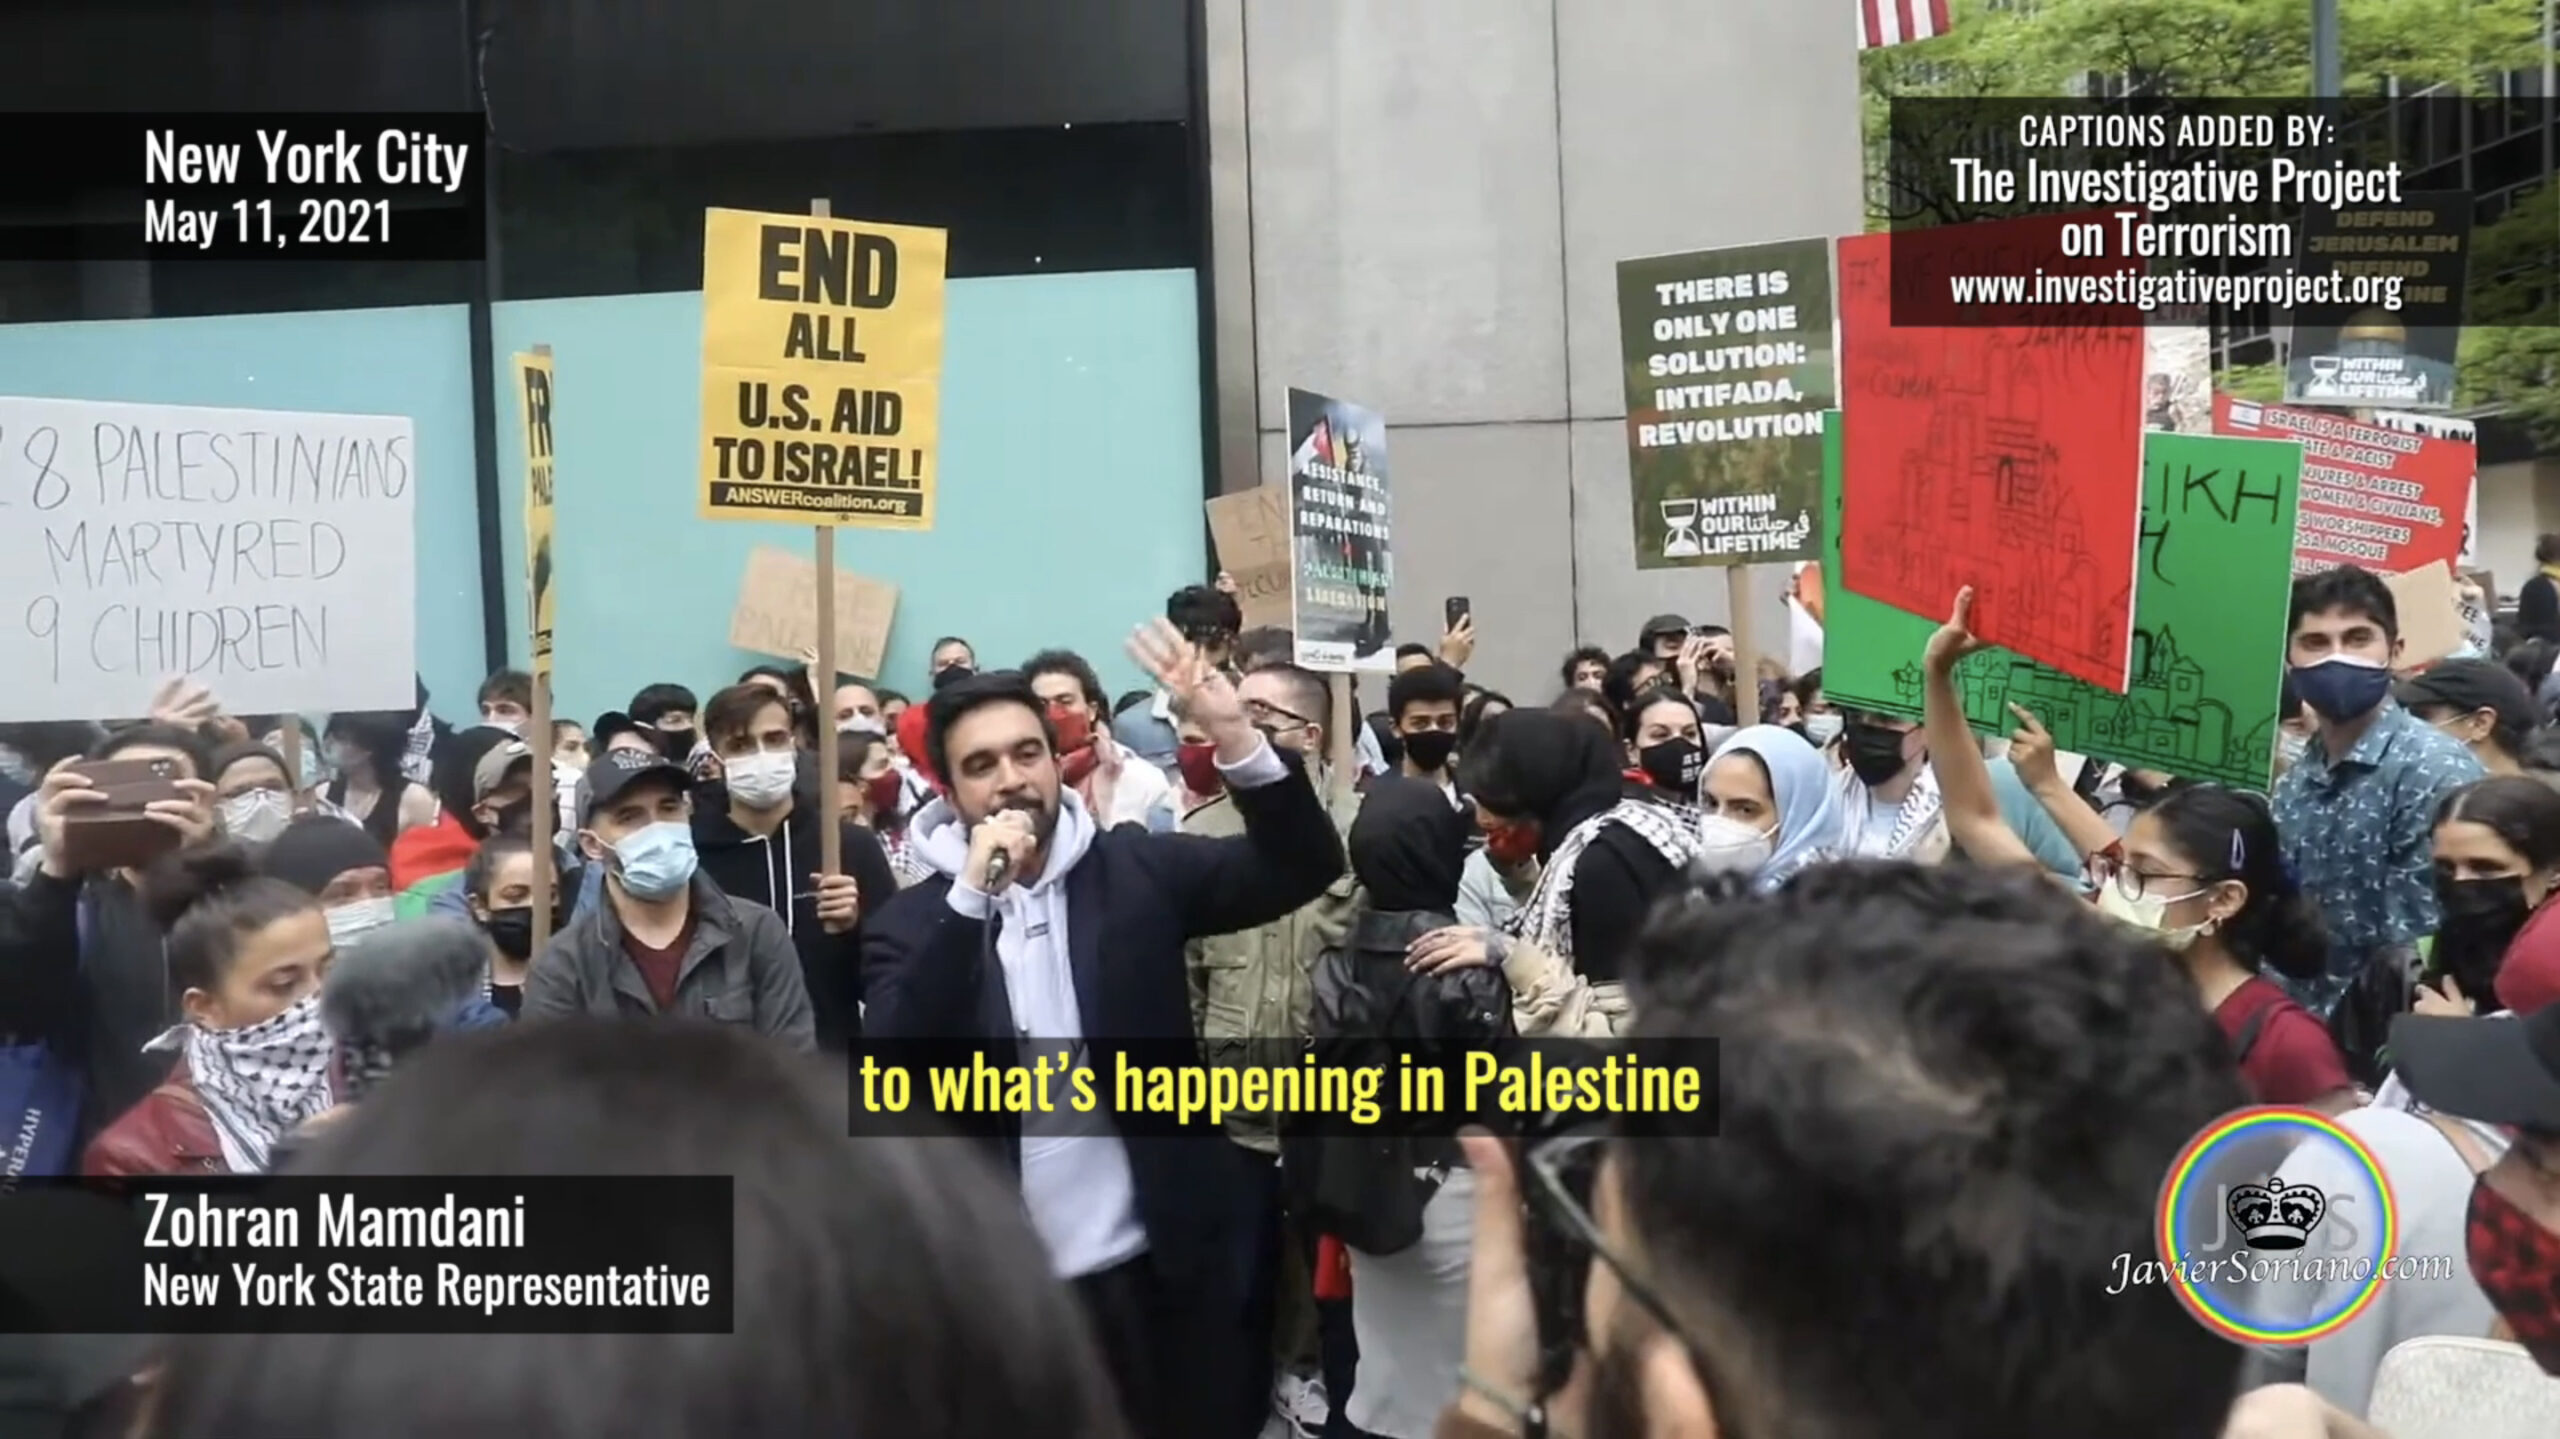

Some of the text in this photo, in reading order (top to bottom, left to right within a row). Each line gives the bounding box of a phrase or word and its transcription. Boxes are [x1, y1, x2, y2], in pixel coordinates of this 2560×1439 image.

[2335, 211, 2434, 228] DEFEND
[2308, 235, 2459, 254] JERUSALEM
[758, 224, 898, 310] END
[2332, 260, 2430, 277] DEFEND
[1656, 270, 1789, 307] THERE IS
[783, 312, 867, 363] ALL
[1653, 305, 1797, 342] ONLY ONE
[1648, 341, 1806, 377] SOLUTION:
[2342, 357, 2403, 372] WITHIN
[738, 381, 903, 437] U.S. AID
[1655, 378, 1804, 411] INTIFADA,
[1639, 411, 1823, 447] REVOLUTION
[2266, 410, 2313, 433] ISRAEL
[2316, 420, 2329, 436] IS
[2333, 423, 2344, 437] A
[2349, 427, 2421, 452] TERRORIST
[94, 420, 410, 505] PALESTINIANS
[712, 437, 922, 490] TO ISRAEL!
[2346, 447, 2394, 467] RACIST
[725, 488, 907, 515] ANSWERcoalition.org
[1701, 494, 1777, 516] WITHIN
[2370, 478, 2421, 499] ARREST
[1701, 514, 1746, 535] OUR
[43, 518, 347, 594] MARTYRED
[1701, 532, 1801, 555] LIFETIME
[2324, 535, 2386, 559] MOSQUE
[25, 595, 329, 684] 9 CHIDREN
